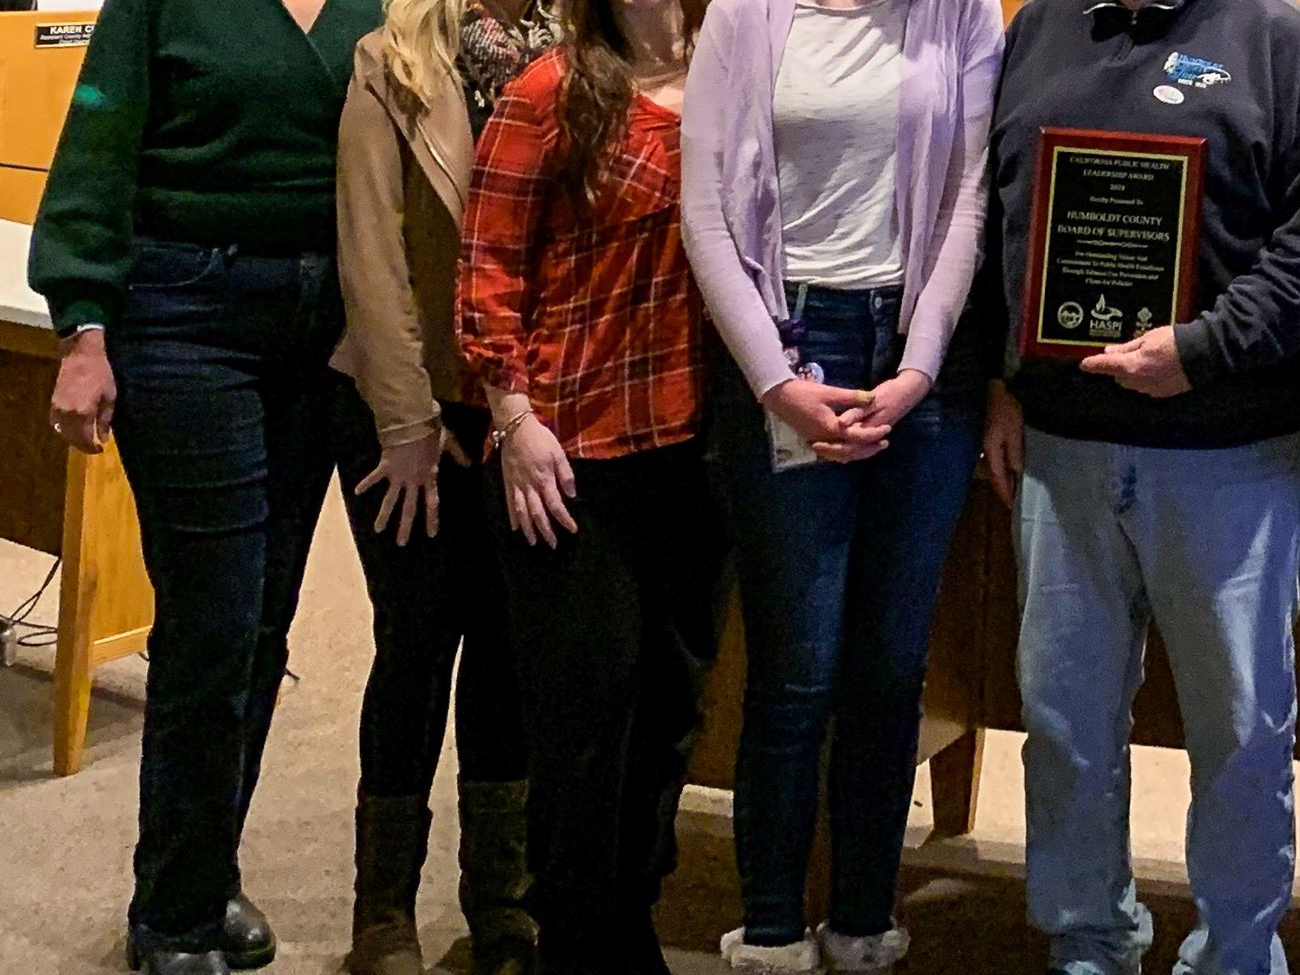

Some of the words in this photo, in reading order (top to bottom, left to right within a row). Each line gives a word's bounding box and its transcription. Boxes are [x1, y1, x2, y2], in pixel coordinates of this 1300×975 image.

[50, 25, 82, 34] KAREN
[1067, 211, 1121, 222] HUMBOLDT
[1122, 215, 1163, 225] COUNTY
[1057, 225, 1091, 235] BOARD
[1092, 227, 1105, 236] OF
[1107, 228, 1170, 241] SUPERVISORS
[1089, 320, 1122, 330] HASPI
